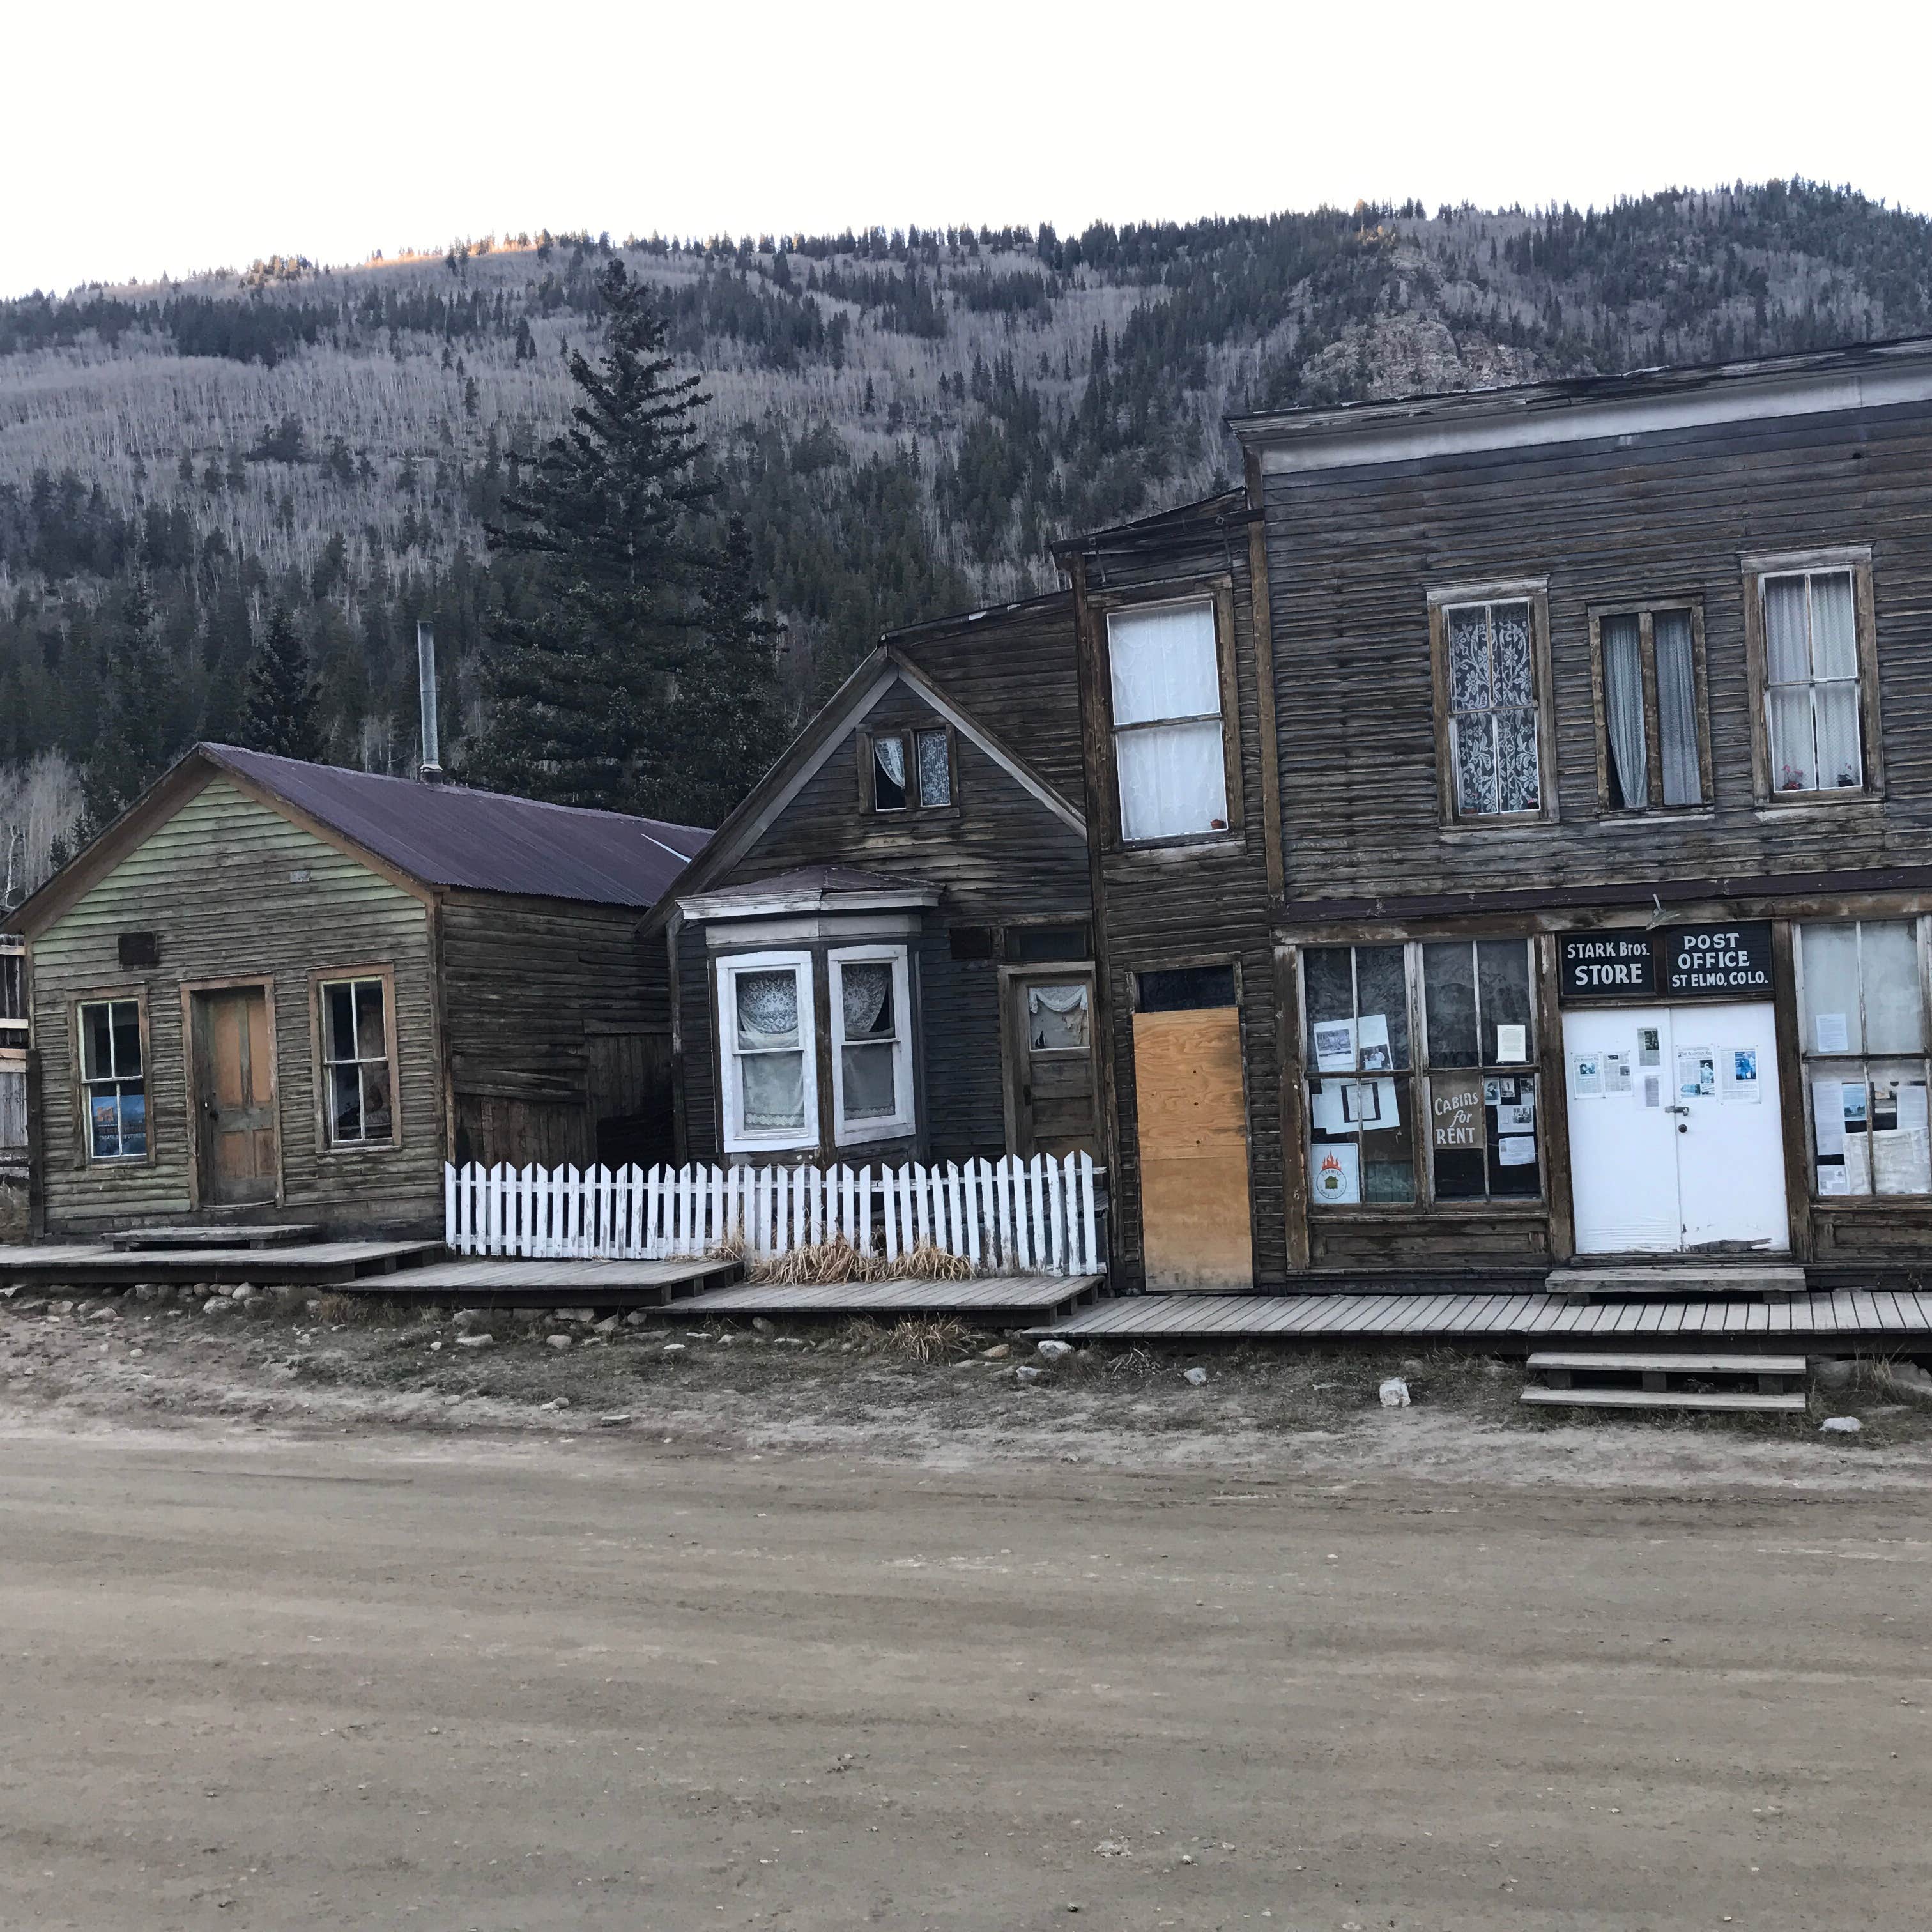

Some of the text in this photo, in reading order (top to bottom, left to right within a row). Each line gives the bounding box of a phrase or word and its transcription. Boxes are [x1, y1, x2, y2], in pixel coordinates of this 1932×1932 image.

[1568, 942, 1650, 958] STARK Bros.
[1683, 933, 1740, 950] POST
[1678, 951, 1749, 969] OFFICE
[1575, 964, 1642, 985] STORE
[1672, 971, 1768, 987] ST ELMO, COLO.
[1449, 1109, 1472, 1127] for
[1436, 1128, 1475, 1144] RENT
